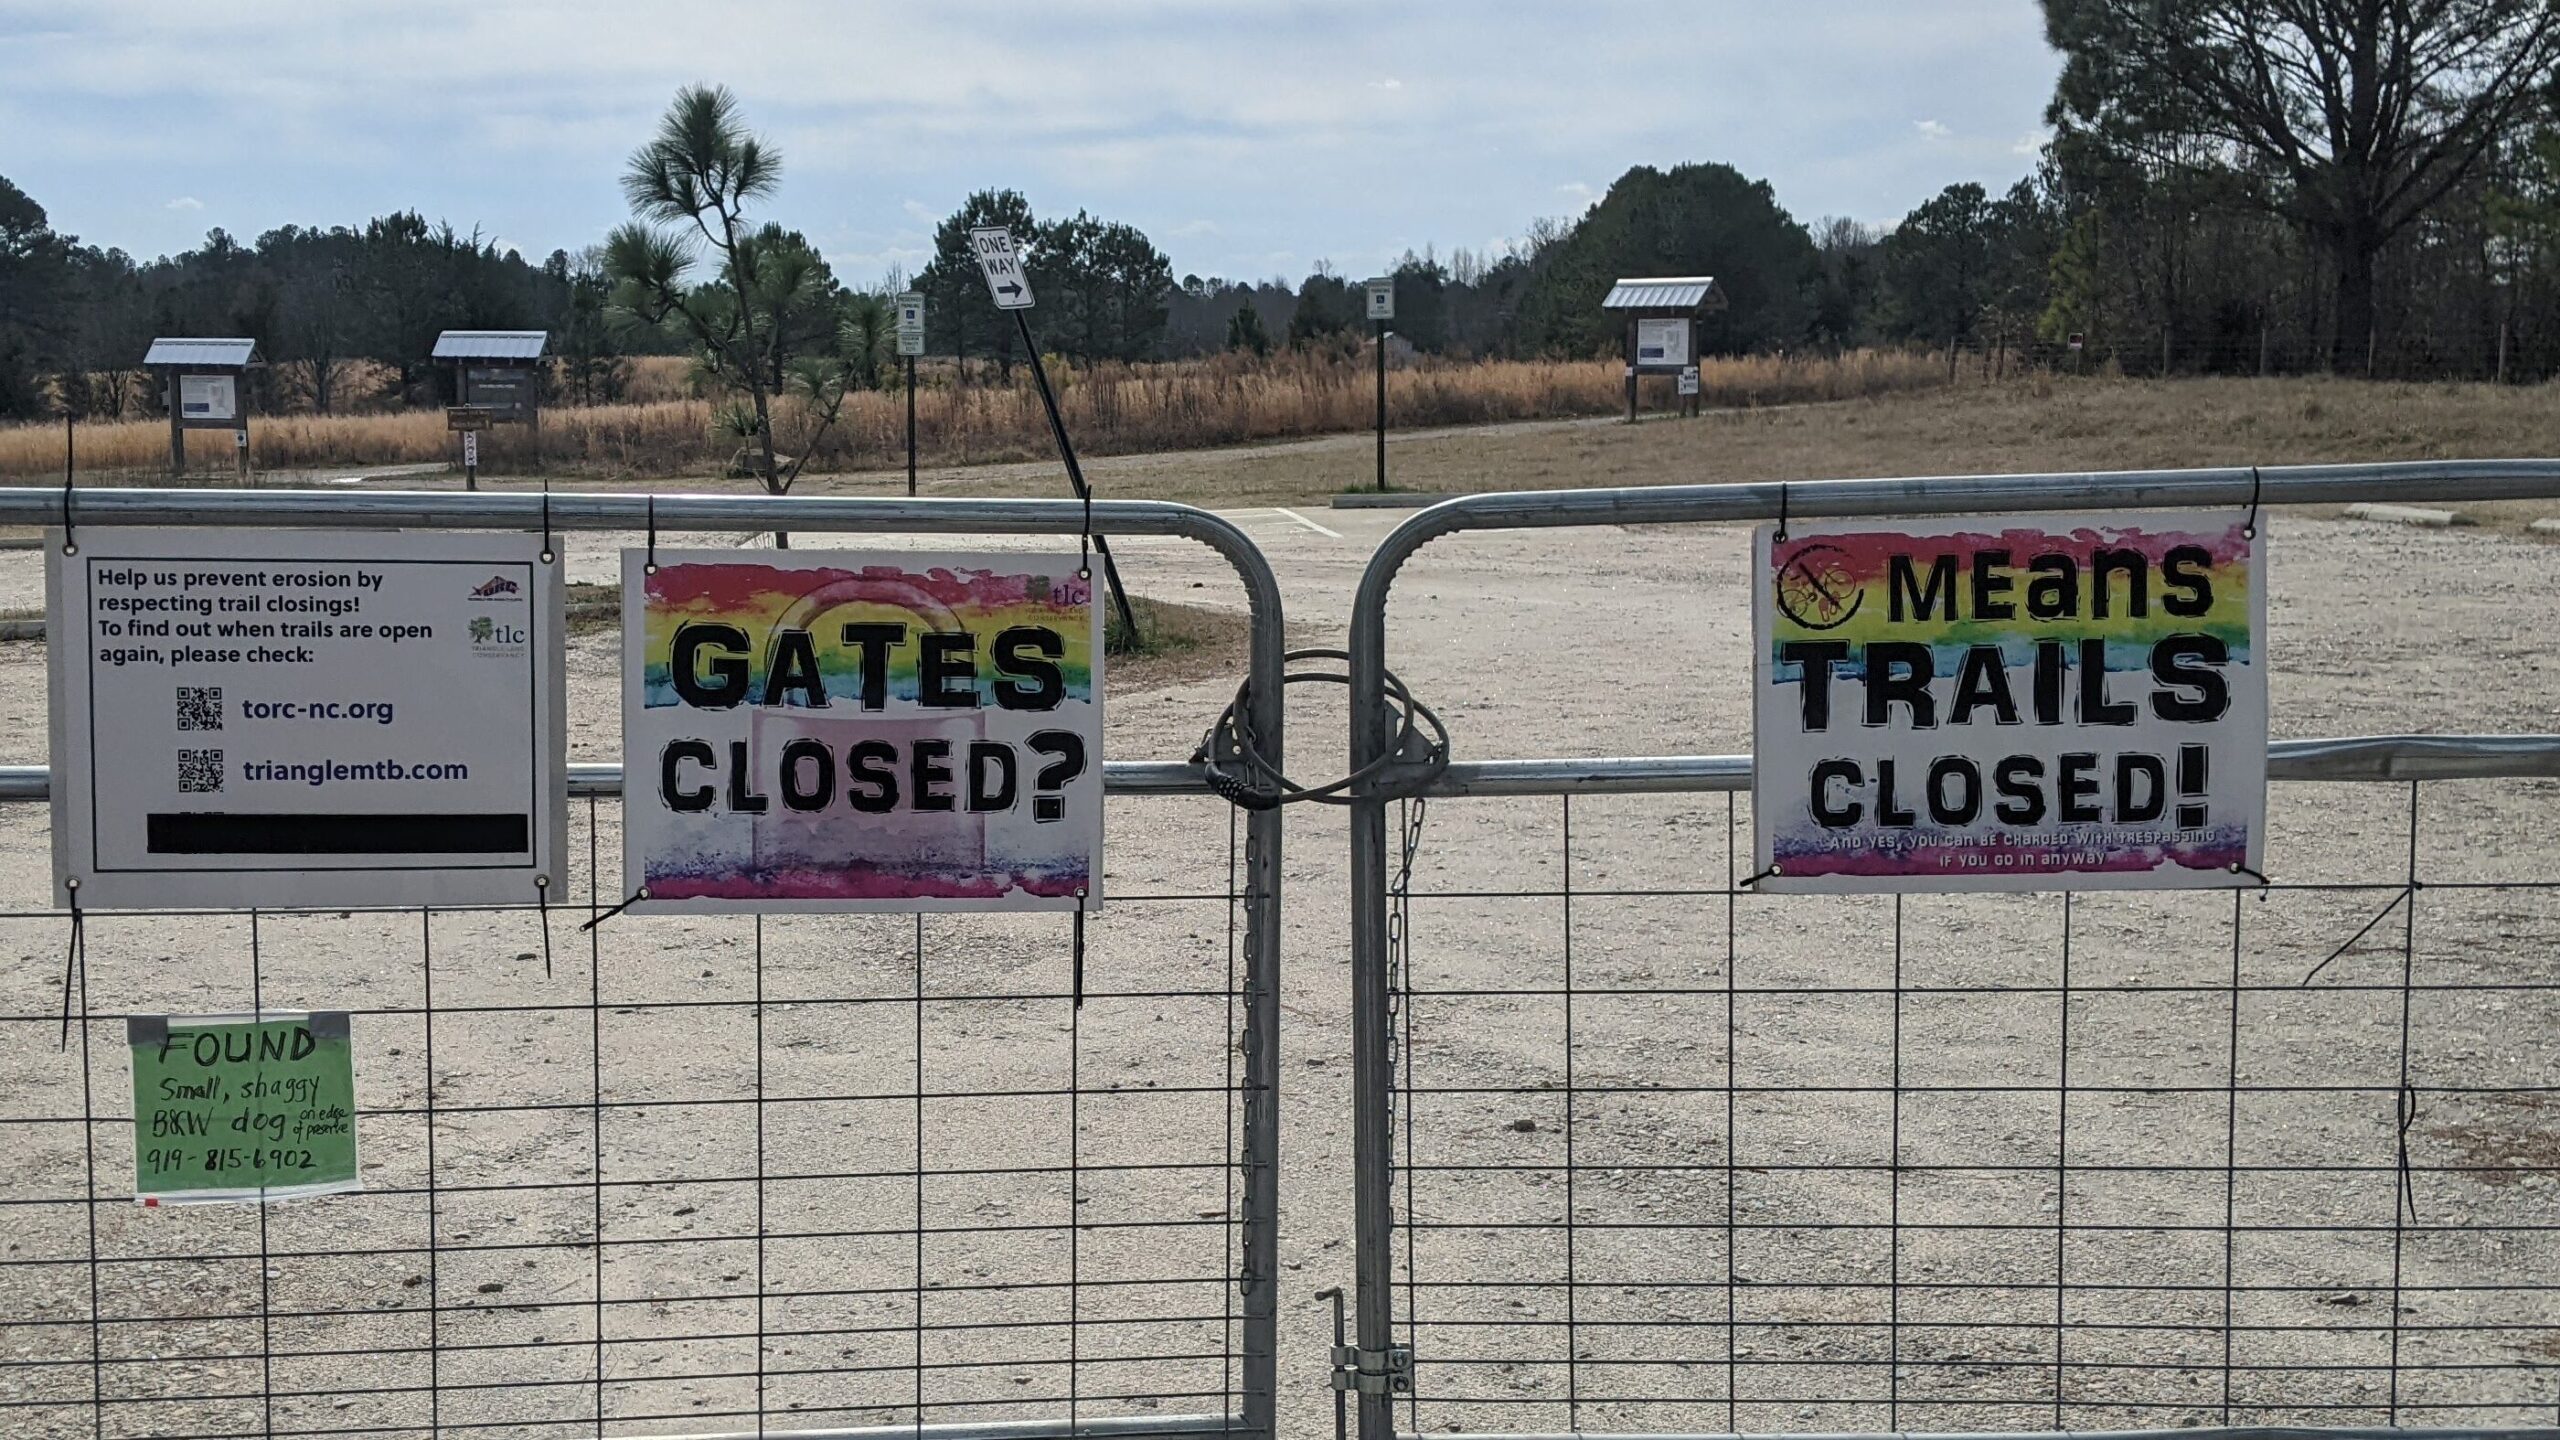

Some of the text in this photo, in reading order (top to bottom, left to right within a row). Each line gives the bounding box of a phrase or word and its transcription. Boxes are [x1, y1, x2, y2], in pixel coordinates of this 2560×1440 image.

[979, 236, 1010, 254] ONE
[985, 257, 1014, 276] WAY
[98, 568, 383, 592] Help us prevent erosion by
[98, 595, 360, 616] respecting trail closings!
[1053, 584, 1086, 606] tlc
[98, 620, 432, 643] To find out when trails are open
[496, 625, 525, 643] tlc
[100, 645, 314, 667] again, please check:
[668, 620, 1067, 712] GATES
[1781, 633, 2232, 732] TRAILS
[242, 700, 394, 724] torc-nc.org
[243, 759, 469, 786] trianglemtb.com
[658, 729, 1088, 824] CLOSED?
[1807, 742, 2210, 829] CLOSED!
[1980, 834, 1997, 846] BE
[1940, 856, 1952, 867] IF
[1994, 854, 2014, 866] GO
[158, 1026, 316, 1067] FOUND
[160, 1071, 320, 1107] Small, shaggy
[152, 1106, 286, 1141] B&W dog
[300, 1104, 349, 1127] on edge
[292, 1120, 349, 1144] of preserve
[147, 1149, 317, 1174] 919-815-6902
